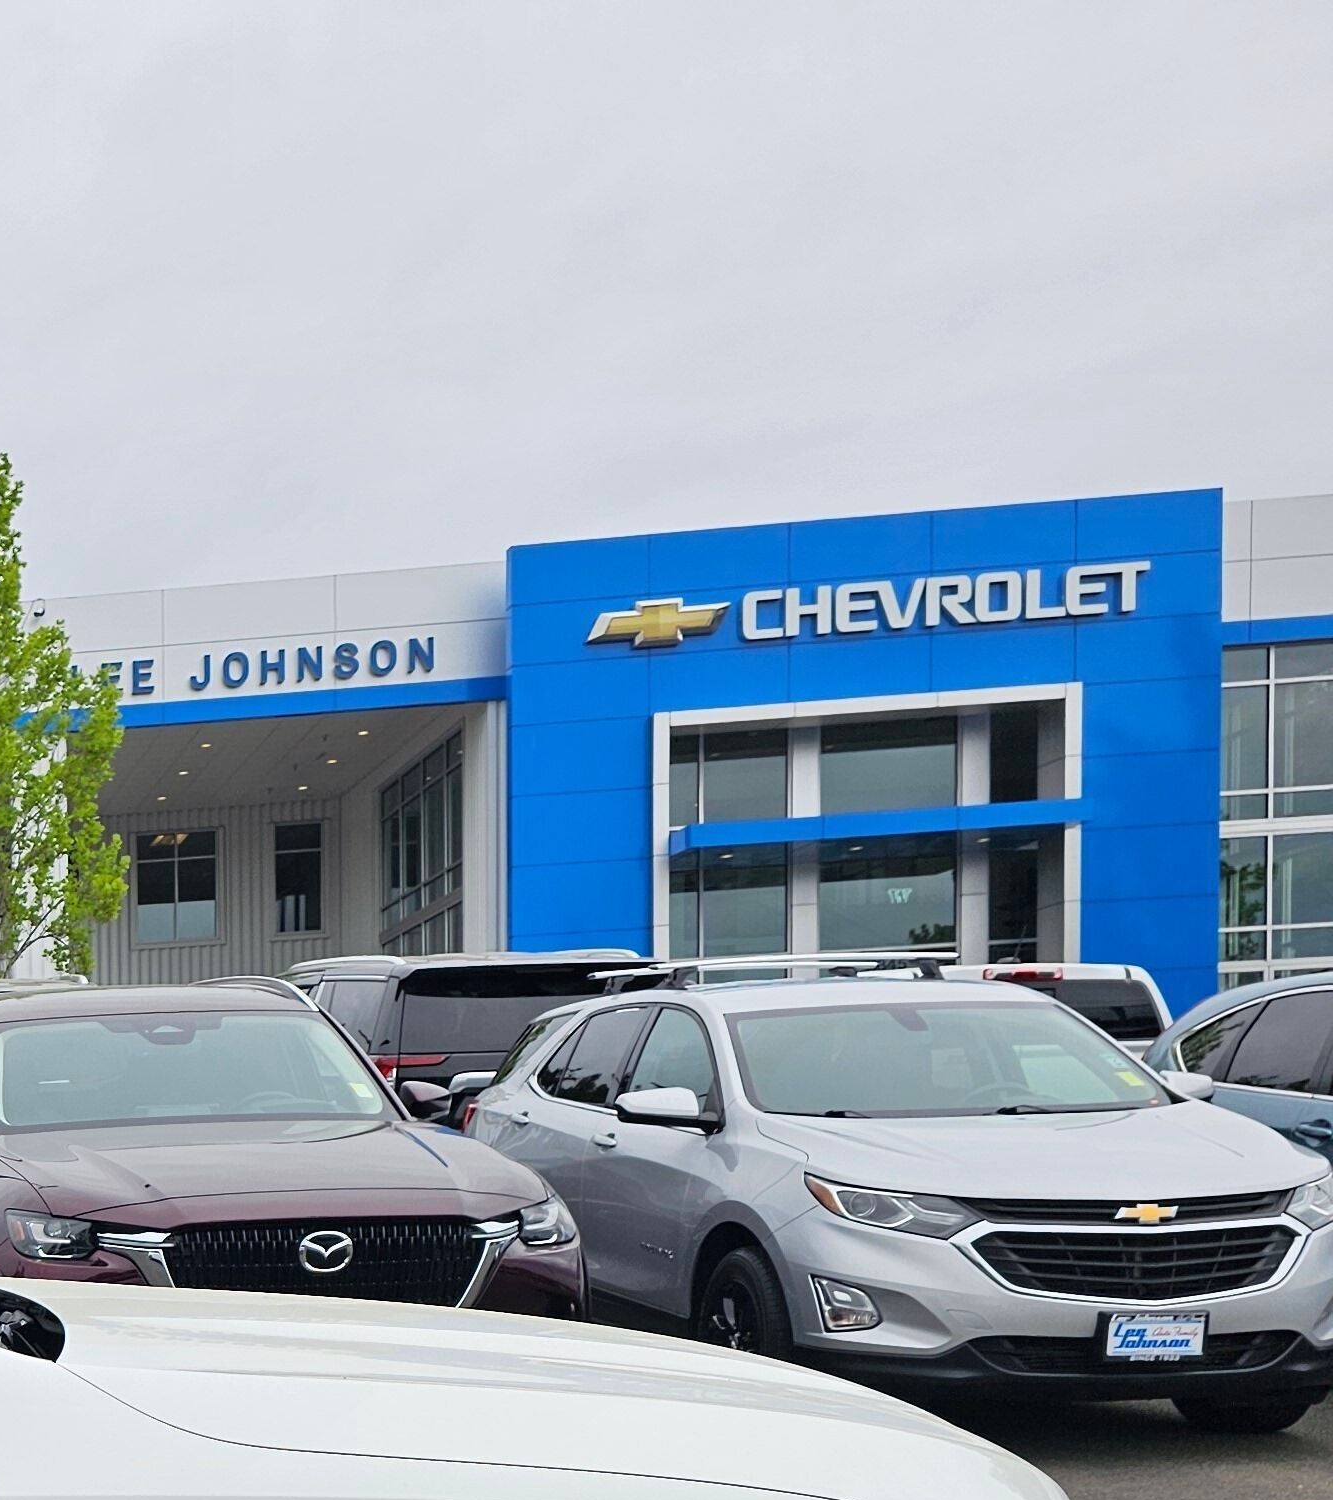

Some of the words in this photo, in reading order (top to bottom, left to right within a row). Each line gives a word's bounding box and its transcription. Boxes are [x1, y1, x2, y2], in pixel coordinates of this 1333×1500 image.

[741, 560, 1152, 640] CHEVROLET
[189, 637, 435, 691] JOHNSON
[1114, 1322, 1148, 1337] Lee
[1114, 1333, 1192, 1349] Johnson
